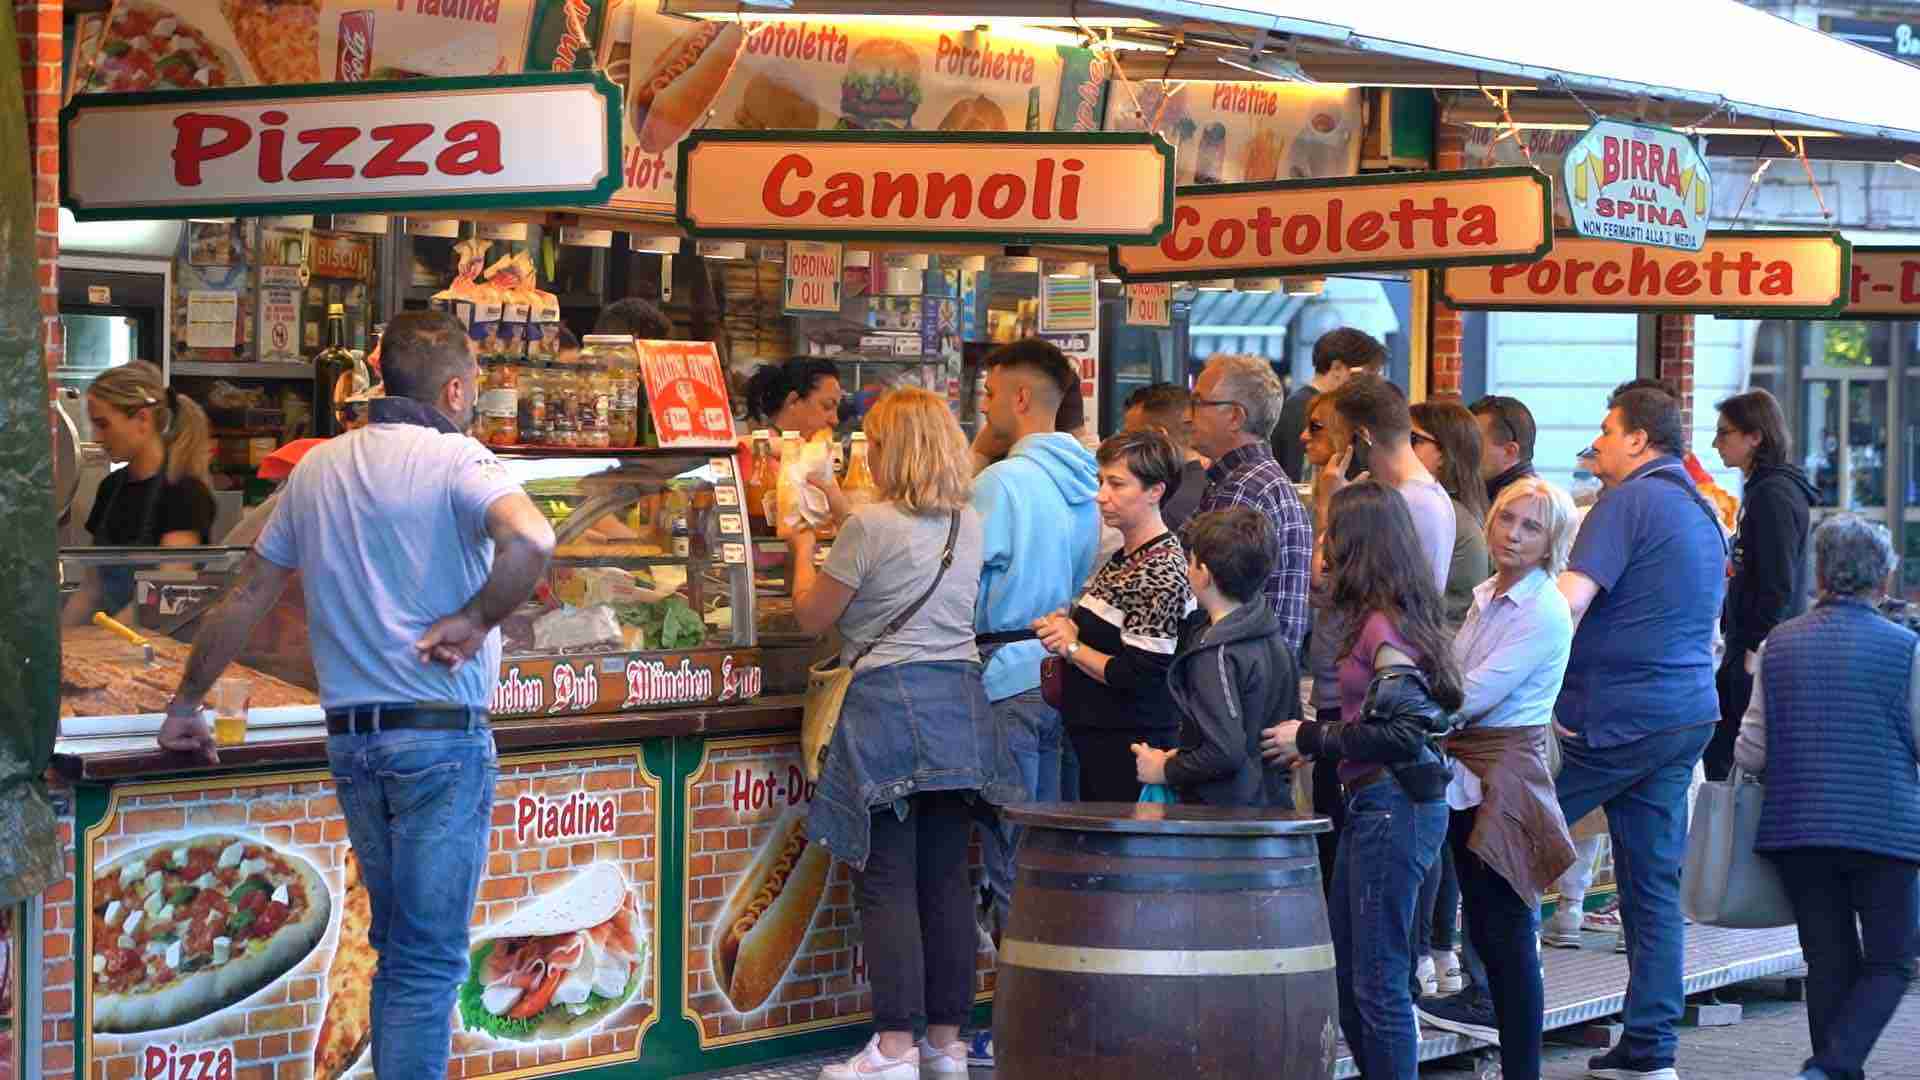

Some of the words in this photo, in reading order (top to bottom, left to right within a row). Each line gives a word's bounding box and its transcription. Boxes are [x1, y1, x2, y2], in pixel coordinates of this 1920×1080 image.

[747, 21, 849, 64] Cotoletta
[935, 33, 1036, 84] Porchetta
[1212, 82, 1278, 117] Patatine
[172, 110, 504, 187] Pizza
[1601, 135, 1682, 197] BIRRA
[761, 153, 1086, 222] Cannoli
[1629, 184, 1658, 202] ALLA
[1161, 196, 1498, 261] Cotoletta
[1583, 217, 1601, 234] NON
[1603, 222, 1643, 241] FERMARTI
[1645, 228, 1664, 244] ALLA
[1674, 231, 1697, 248] MEDIA
[1595, 198, 1688, 229] SPINA
[792, 255, 834, 279] ORDINA
[1488, 248, 1795, 297] Porchetta
[802, 282, 825, 305] QUI
[1138, 300, 1158, 320] QUI
[549, 663, 598, 713] Pub
[623, 659, 713, 708] München
[516, 794, 615, 842] Piadina
[144, 1043, 233, 1080] Pizza
